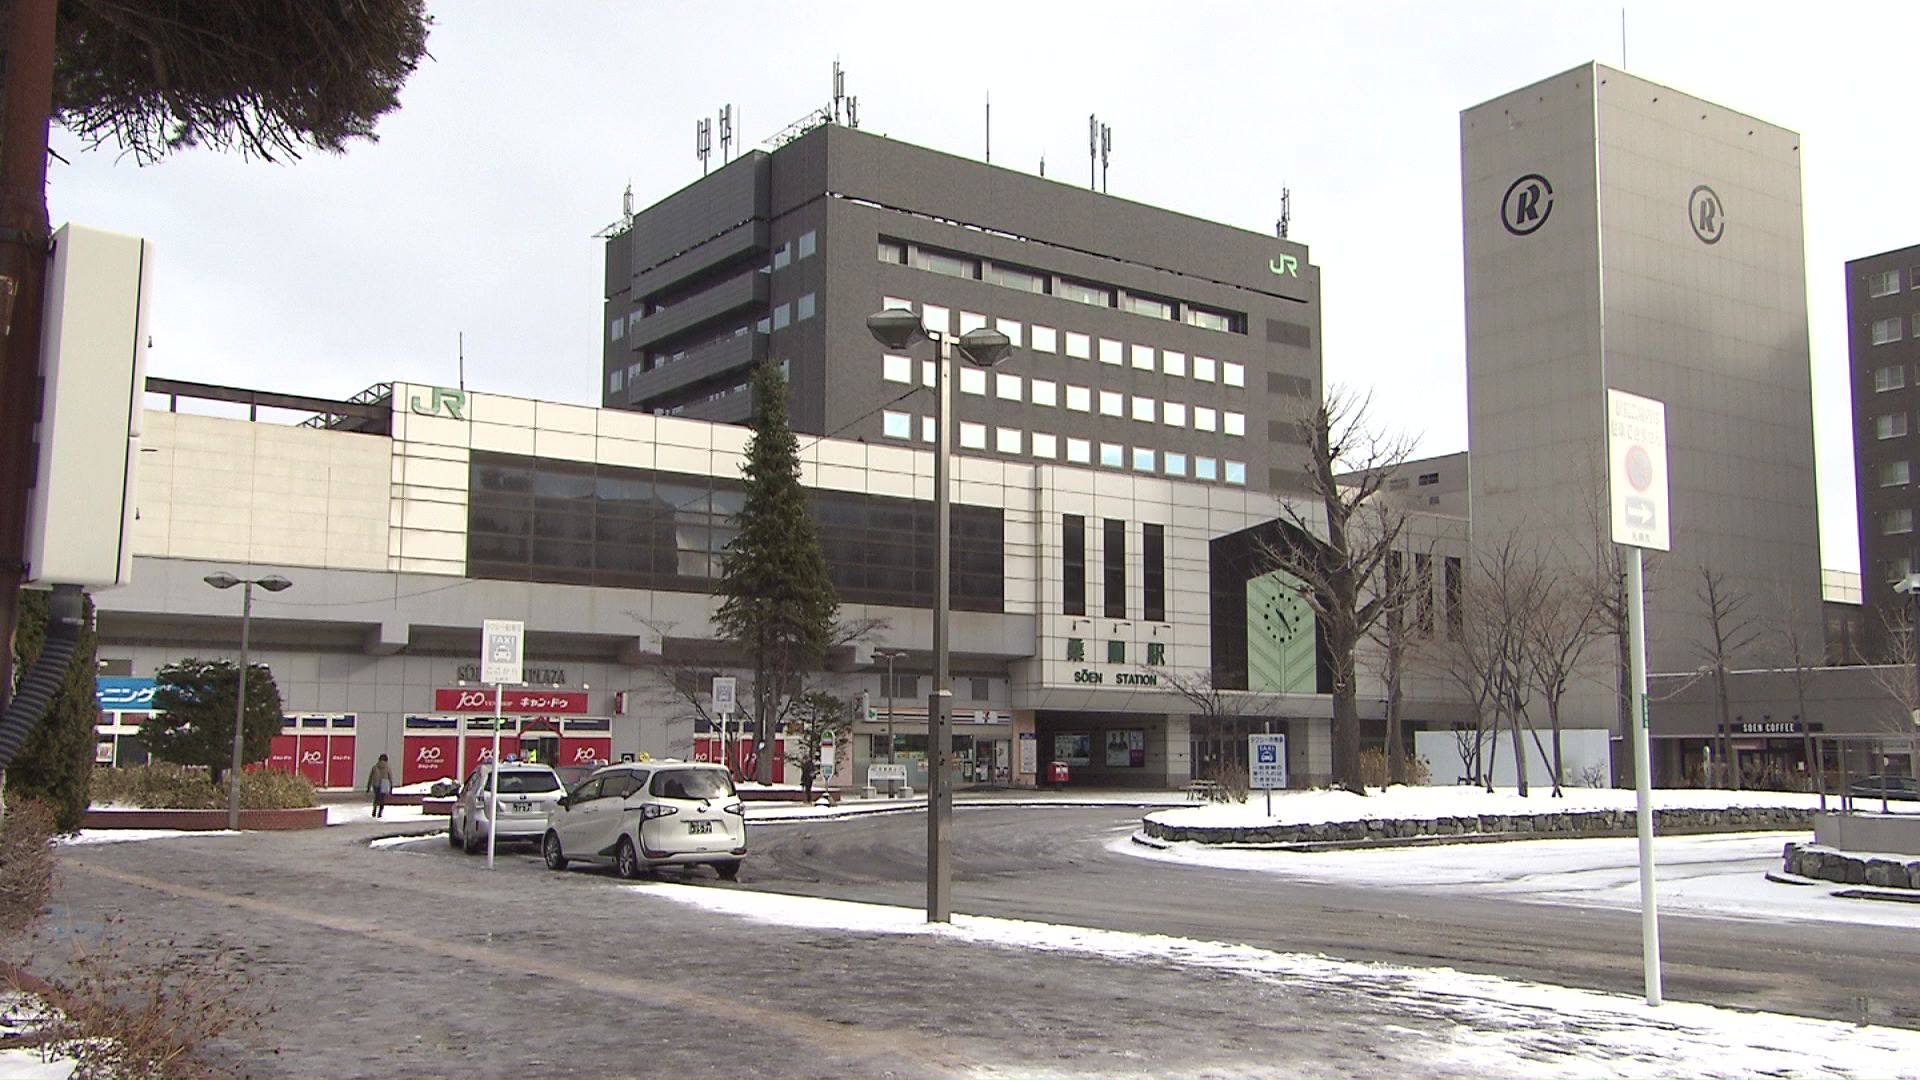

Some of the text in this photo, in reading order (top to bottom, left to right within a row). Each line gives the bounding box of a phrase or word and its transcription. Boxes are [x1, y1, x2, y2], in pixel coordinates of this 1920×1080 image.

[1269, 253, 1298, 278] JR
[411, 386, 466, 421] JR
[491, 635, 516, 646] TAXI
[1115, 673, 1157, 686] STATION
[96, 686, 157, 703] ニング
[1765, 722, 1795, 733] COFFEE
